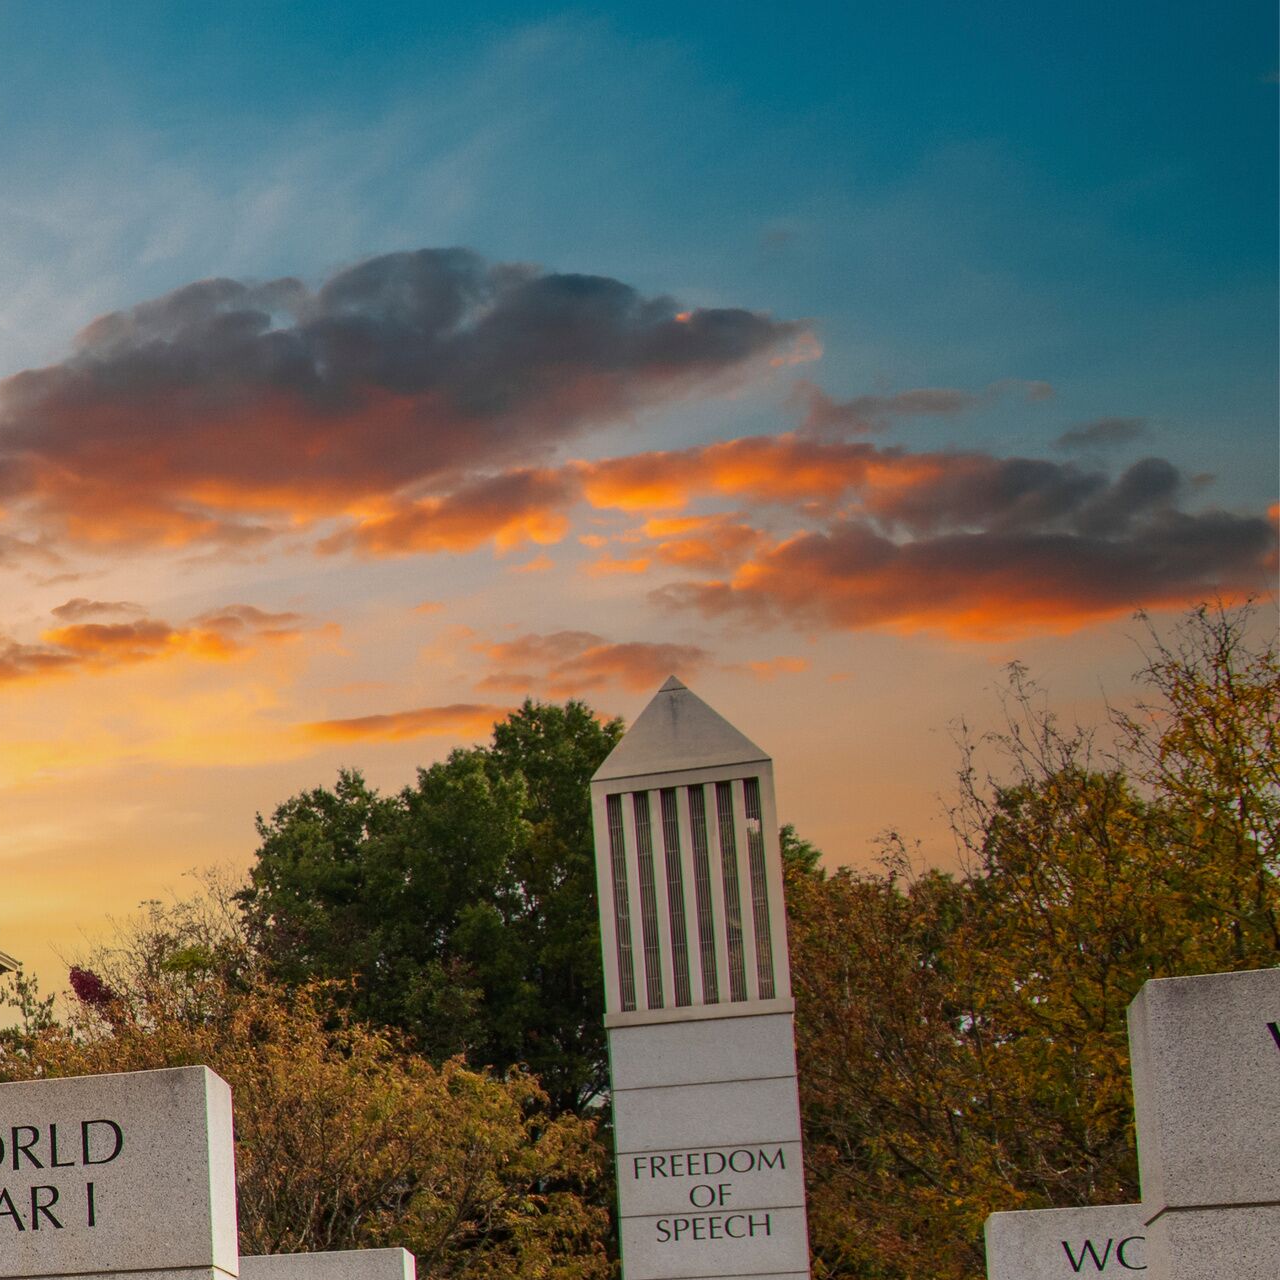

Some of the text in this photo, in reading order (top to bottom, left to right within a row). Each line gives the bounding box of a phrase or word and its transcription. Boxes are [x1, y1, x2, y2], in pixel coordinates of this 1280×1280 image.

[633, 1148, 786, 1180] FREEDOM
[85, 1181, 96, 1228] I
[689, 1184, 734, 1208] OF
[655, 1213, 771, 1243] SPEECH
